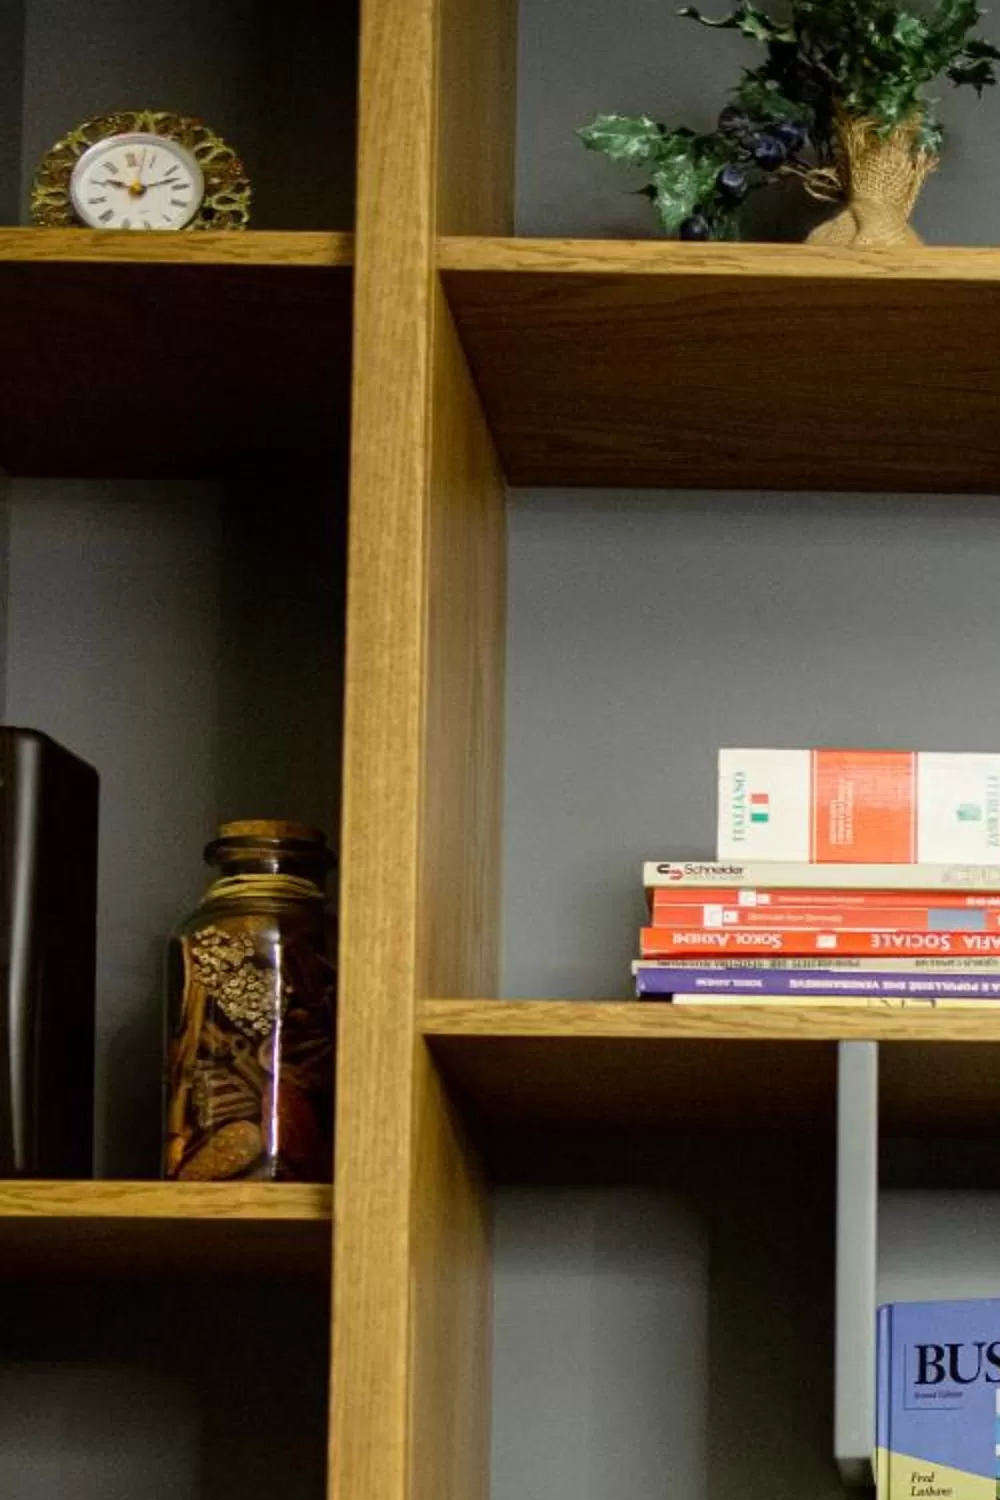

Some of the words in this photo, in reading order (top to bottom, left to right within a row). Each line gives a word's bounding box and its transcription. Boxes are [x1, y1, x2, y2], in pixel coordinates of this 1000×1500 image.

[735, 933, 783, 949] SOKOL
[871, 934, 950, 950] SOCIALE
[911, 1471, 935, 1483] Fred
